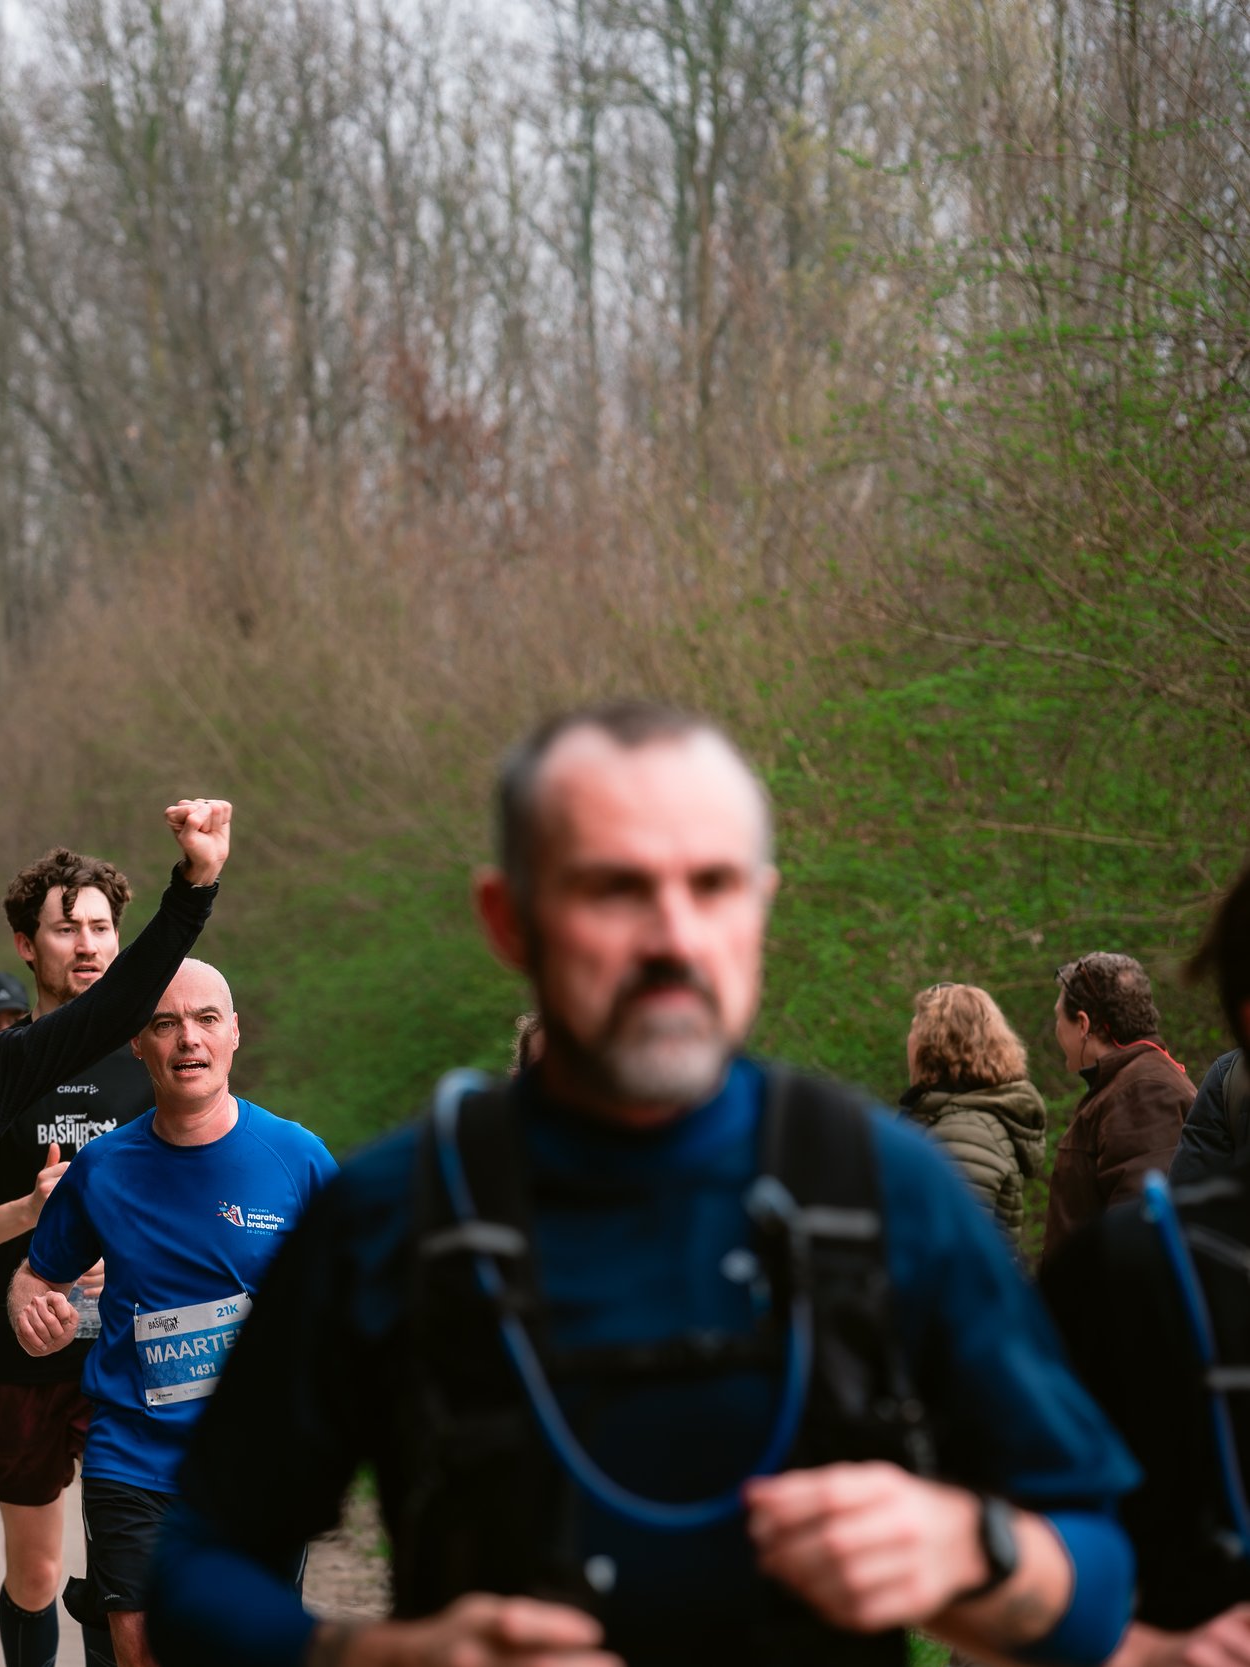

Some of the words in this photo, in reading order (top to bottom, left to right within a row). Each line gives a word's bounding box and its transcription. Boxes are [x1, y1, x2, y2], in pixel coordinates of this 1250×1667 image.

[56, 1085, 90, 1094] CRAFT
[37, 1121, 104, 1145] BASHIR'S
[246, 1219, 279, 1231] brabant
[247, 1213, 285, 1224] marathon
[216, 1303, 239, 1318] 21K
[145, 1328, 242, 1365] MAARTE
[189, 1361, 216, 1378] 1431
